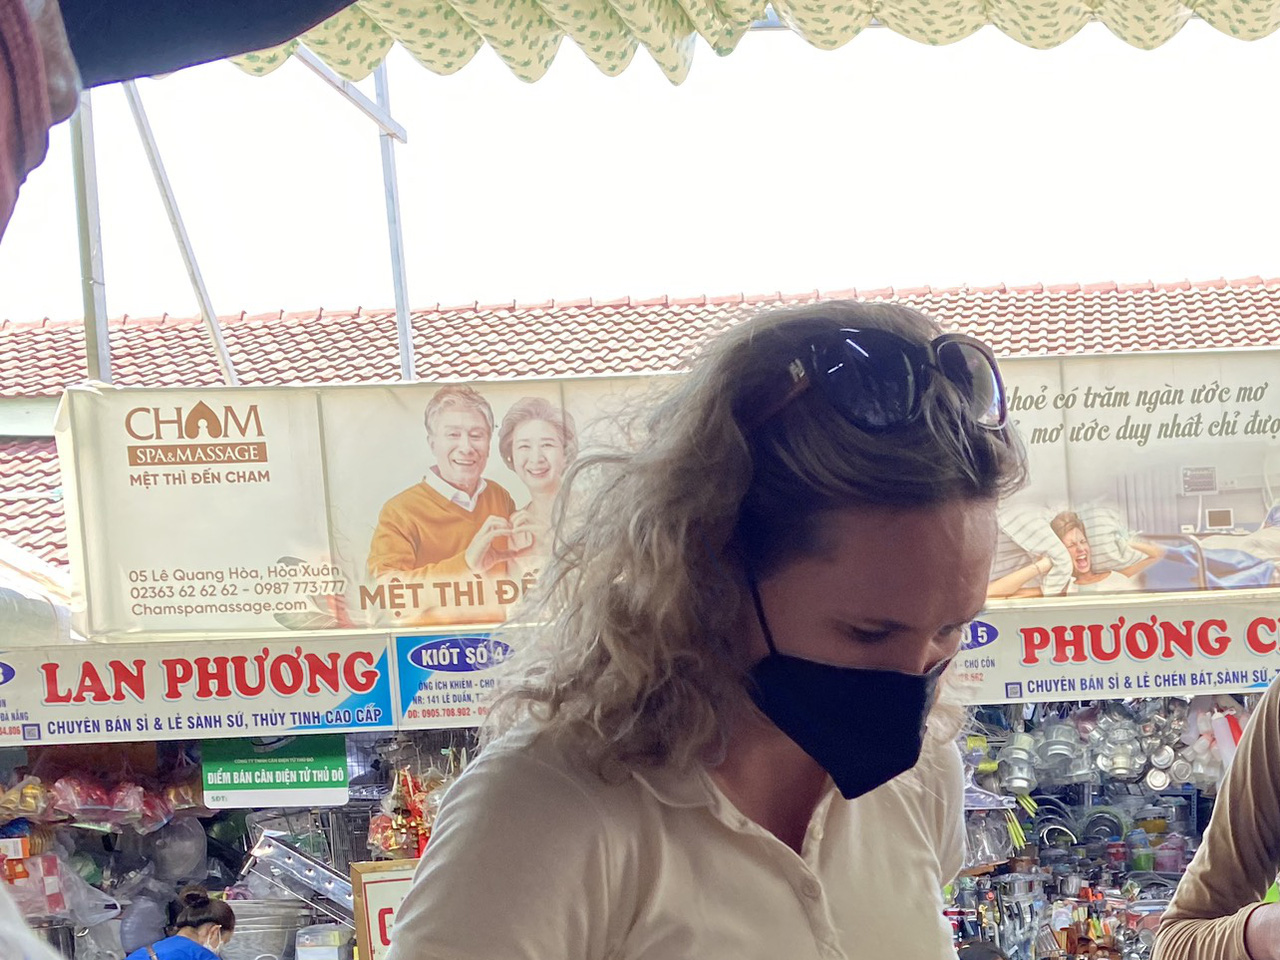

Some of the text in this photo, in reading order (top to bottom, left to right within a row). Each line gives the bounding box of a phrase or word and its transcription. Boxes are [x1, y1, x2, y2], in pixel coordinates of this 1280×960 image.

[1053, 387, 1079, 409] có
[1084, 385, 1130, 408] trăm
[1135, 383, 1184, 413] ngàn
[1190, 380, 1231, 404] ước
[1236, 382, 1269, 403] mơ
[125, 399, 265, 441] CHAM
[1031, 424, 1063, 444] mơ
[1069, 419, 1110, 442] ước
[1116, 415, 1152, 447] duy
[1157, 412, 1203, 439] nhất
[1208, 411, 1240, 436] chỉ
[136, 445, 259, 464] SPA&MASSAGE
[130, 467, 270, 489] MỆT THÌ ĐẾN CHAM
[129, 564, 339, 582] 05 Lê Quang Hòa, Hòa Xuân
[130, 586, 174, 599] 02363
[178, 586, 196, 597] 62
[200, 585, 217, 597] 62
[221, 584, 238, 596] 62
[254, 582, 289, 595] 0987
[293, 581, 318, 593] 773
[321, 580, 345, 592] 777
[359, 577, 424, 617] MỆT
[433, 574, 484, 607] THÌ
[131, 600, 307, 617] Chamspamassage.com
[977, 627, 987, 643] 5
[1019, 614, 1231, 664] PHƯƠNG
[421, 643, 460, 666] KIỐT
[466, 641, 488, 664] SỐ
[41, 646, 379, 703] LAN PHƯƠNG
[1027, 675, 1075, 693] CHUYÊN
[1080, 676, 1103, 690] BÁN
[1108, 672, 1119, 689] SỈ
[1123, 676, 1133, 689] &
[1137, 671, 1150, 688] LẺ
[1154, 671, 1186, 687] CHÉN
[427, 695, 440, 704] 141
[47, 716, 100, 735] CHUYÊN
[105, 715, 131, 732] BÁN
[137, 713, 149, 731] SỈ
[154, 717, 163, 731] &
[168, 712, 182, 730] LẺ
[187, 713, 222, 730] SÀNH
[252, 708, 286, 726] THỦY
[290, 711, 320, 725] TINH
[325, 709, 350, 724] CAO
[356, 703, 382, 722] CẤP
[207, 767, 231, 784] ĐIỂM
[233, 769, 252, 784] BÁN
[254, 768, 273, 783] CÂN
[275, 767, 297, 785] ĐIỆN
[312, 766, 329, 782] THỦ
[331, 767, 344, 782] ĐÔ
